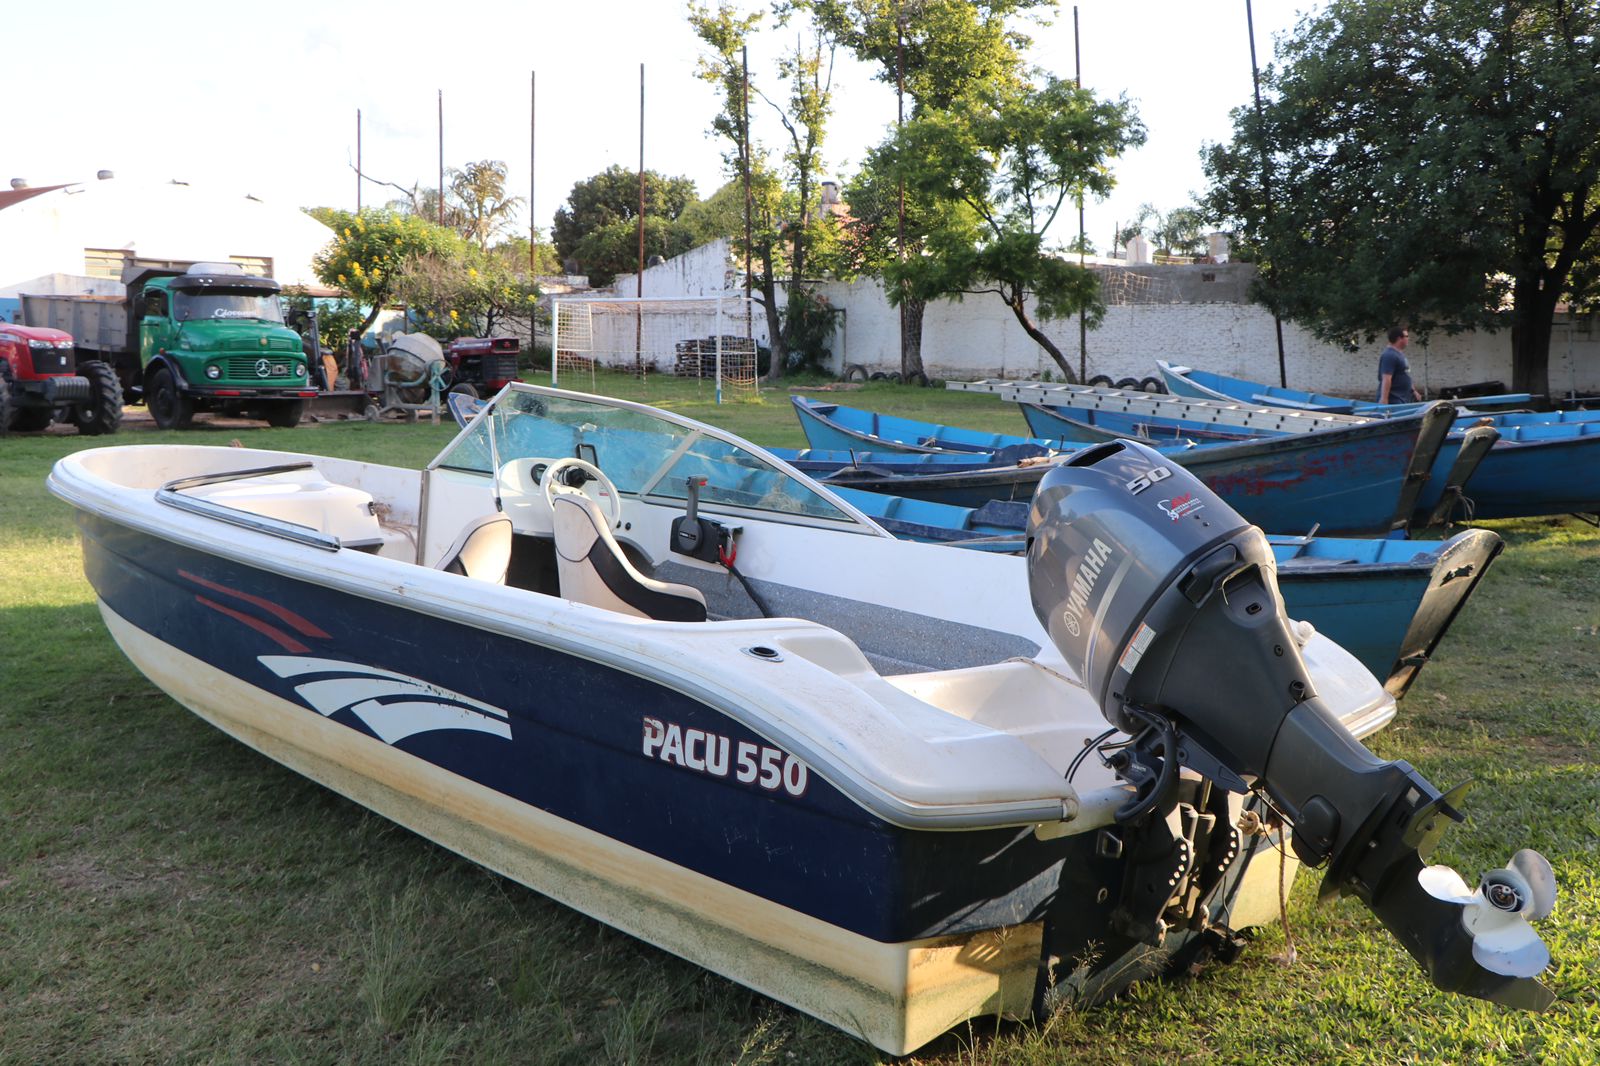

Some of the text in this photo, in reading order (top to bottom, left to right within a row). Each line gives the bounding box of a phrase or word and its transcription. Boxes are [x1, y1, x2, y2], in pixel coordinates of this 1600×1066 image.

[1126, 466, 1171, 495] 50
[1067, 538, 1113, 618] YAMAHA
[643, 717, 808, 796] PACU 550
